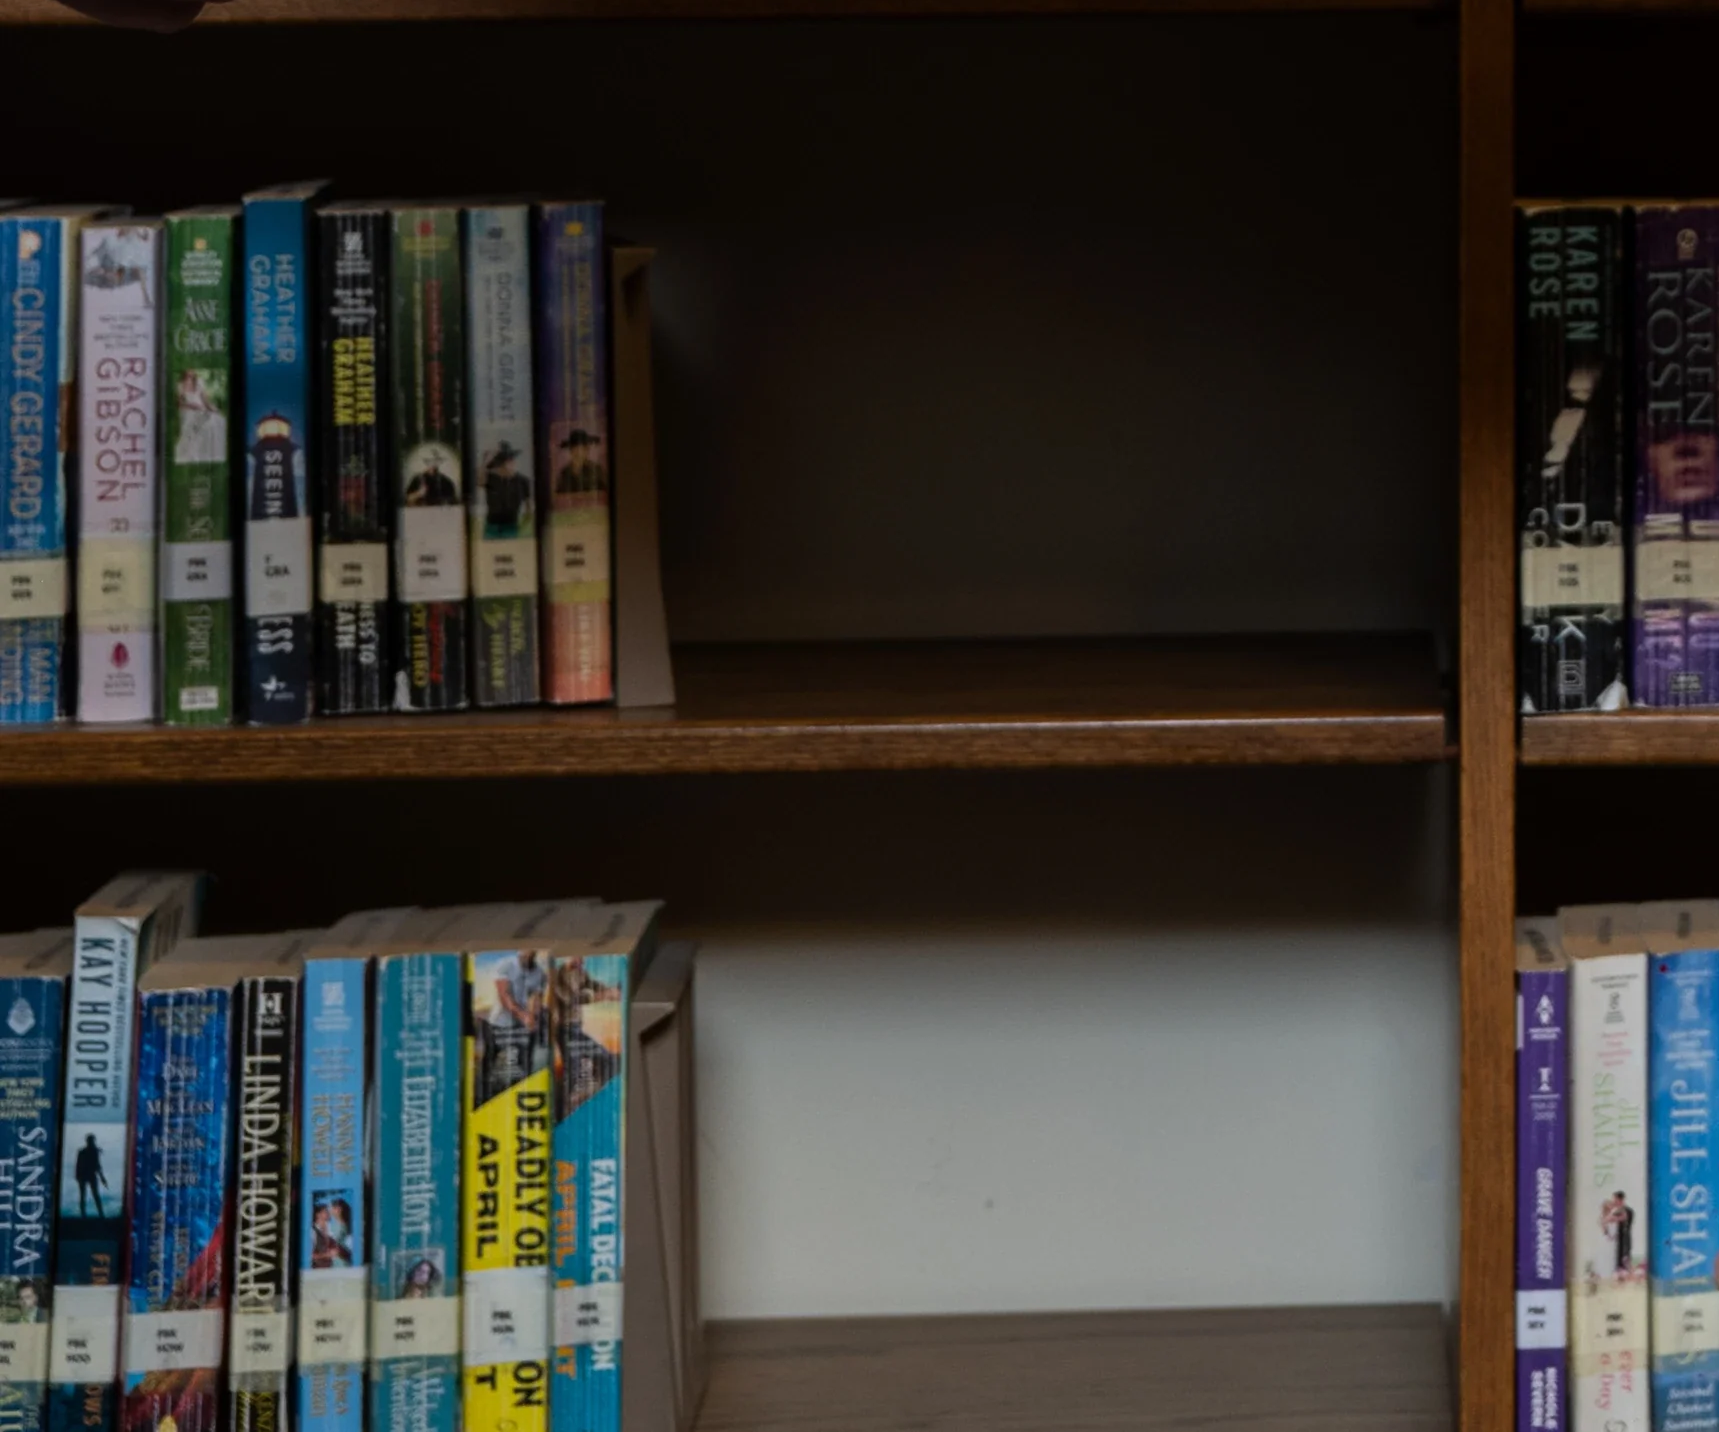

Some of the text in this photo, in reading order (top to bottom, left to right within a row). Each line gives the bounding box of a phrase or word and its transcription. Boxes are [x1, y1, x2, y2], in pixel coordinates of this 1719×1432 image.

[250, 255, 271, 364] GRAHAM
[274, 255, 295, 363] HEATHER
[1530, 227, 1559, 319] ROSE
[1566, 226, 1597, 340] KAREN
[333, 339, 352, 427] GRAHAM
[354, 338, 374, 426] HEATHER
[1647, 271, 1682, 425] ROSE
[1686, 267, 1716, 425] KAREN
[9, 289, 43, 518] CINDY GERARD
[97, 358, 120, 502] GIBSON
[121, 357, 146, 498] RACHEL
[73, 935, 111, 1108] KAY HOOPER
[240, 1055, 277, 1156] LINDA
[514, 1092, 545, 1215] DEADLY
[1594, 1073, 1616, 1187] SHALVIS
[1670, 1080, 1708, 1172] JILL
[13, 1126, 48, 1268] SANDRA
[476, 1134, 498, 1257] APRIL
[555, 1160, 575, 1265] APRIL
[591, 1159, 615, 1230] FATAL
[1535, 1168, 1554, 1278] GRAVE DANGER
